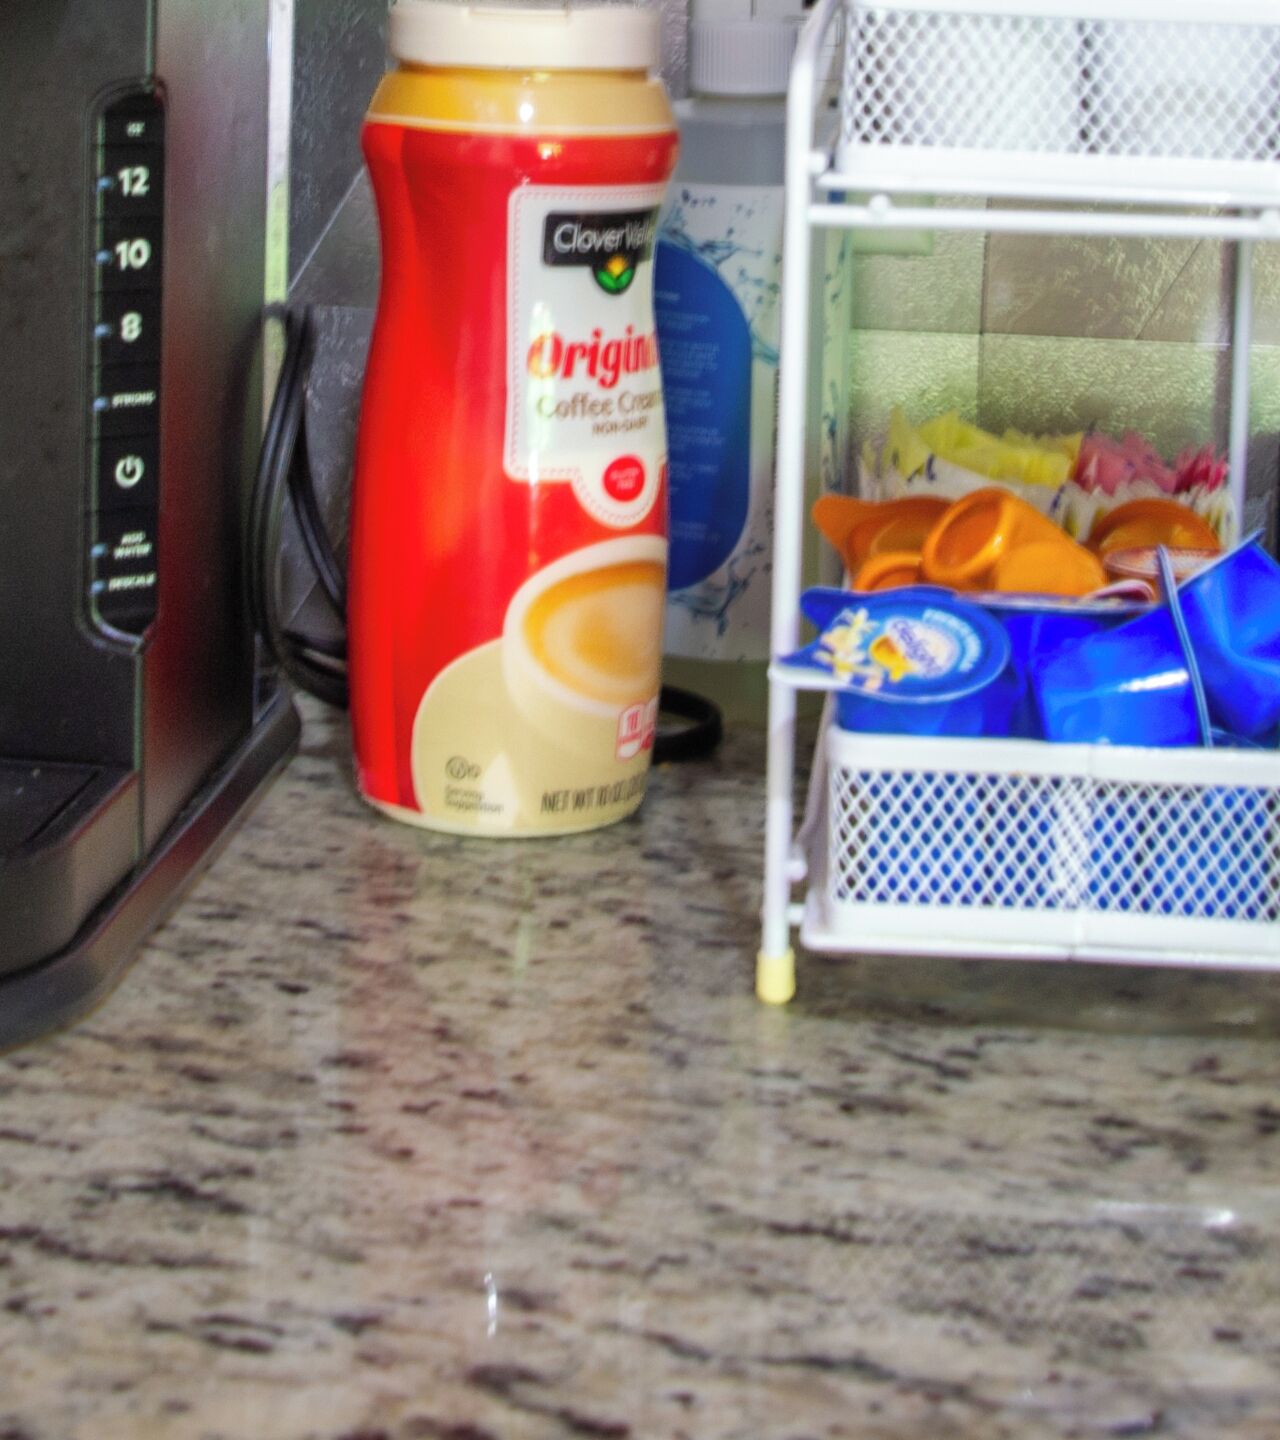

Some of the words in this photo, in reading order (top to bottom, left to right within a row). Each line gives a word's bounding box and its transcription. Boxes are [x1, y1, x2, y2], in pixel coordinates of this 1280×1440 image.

[118, 166, 150, 198] 12
[114, 238, 151, 270] 10
[120, 312, 143, 343] 8
[535, 392, 614, 419] Coffee
